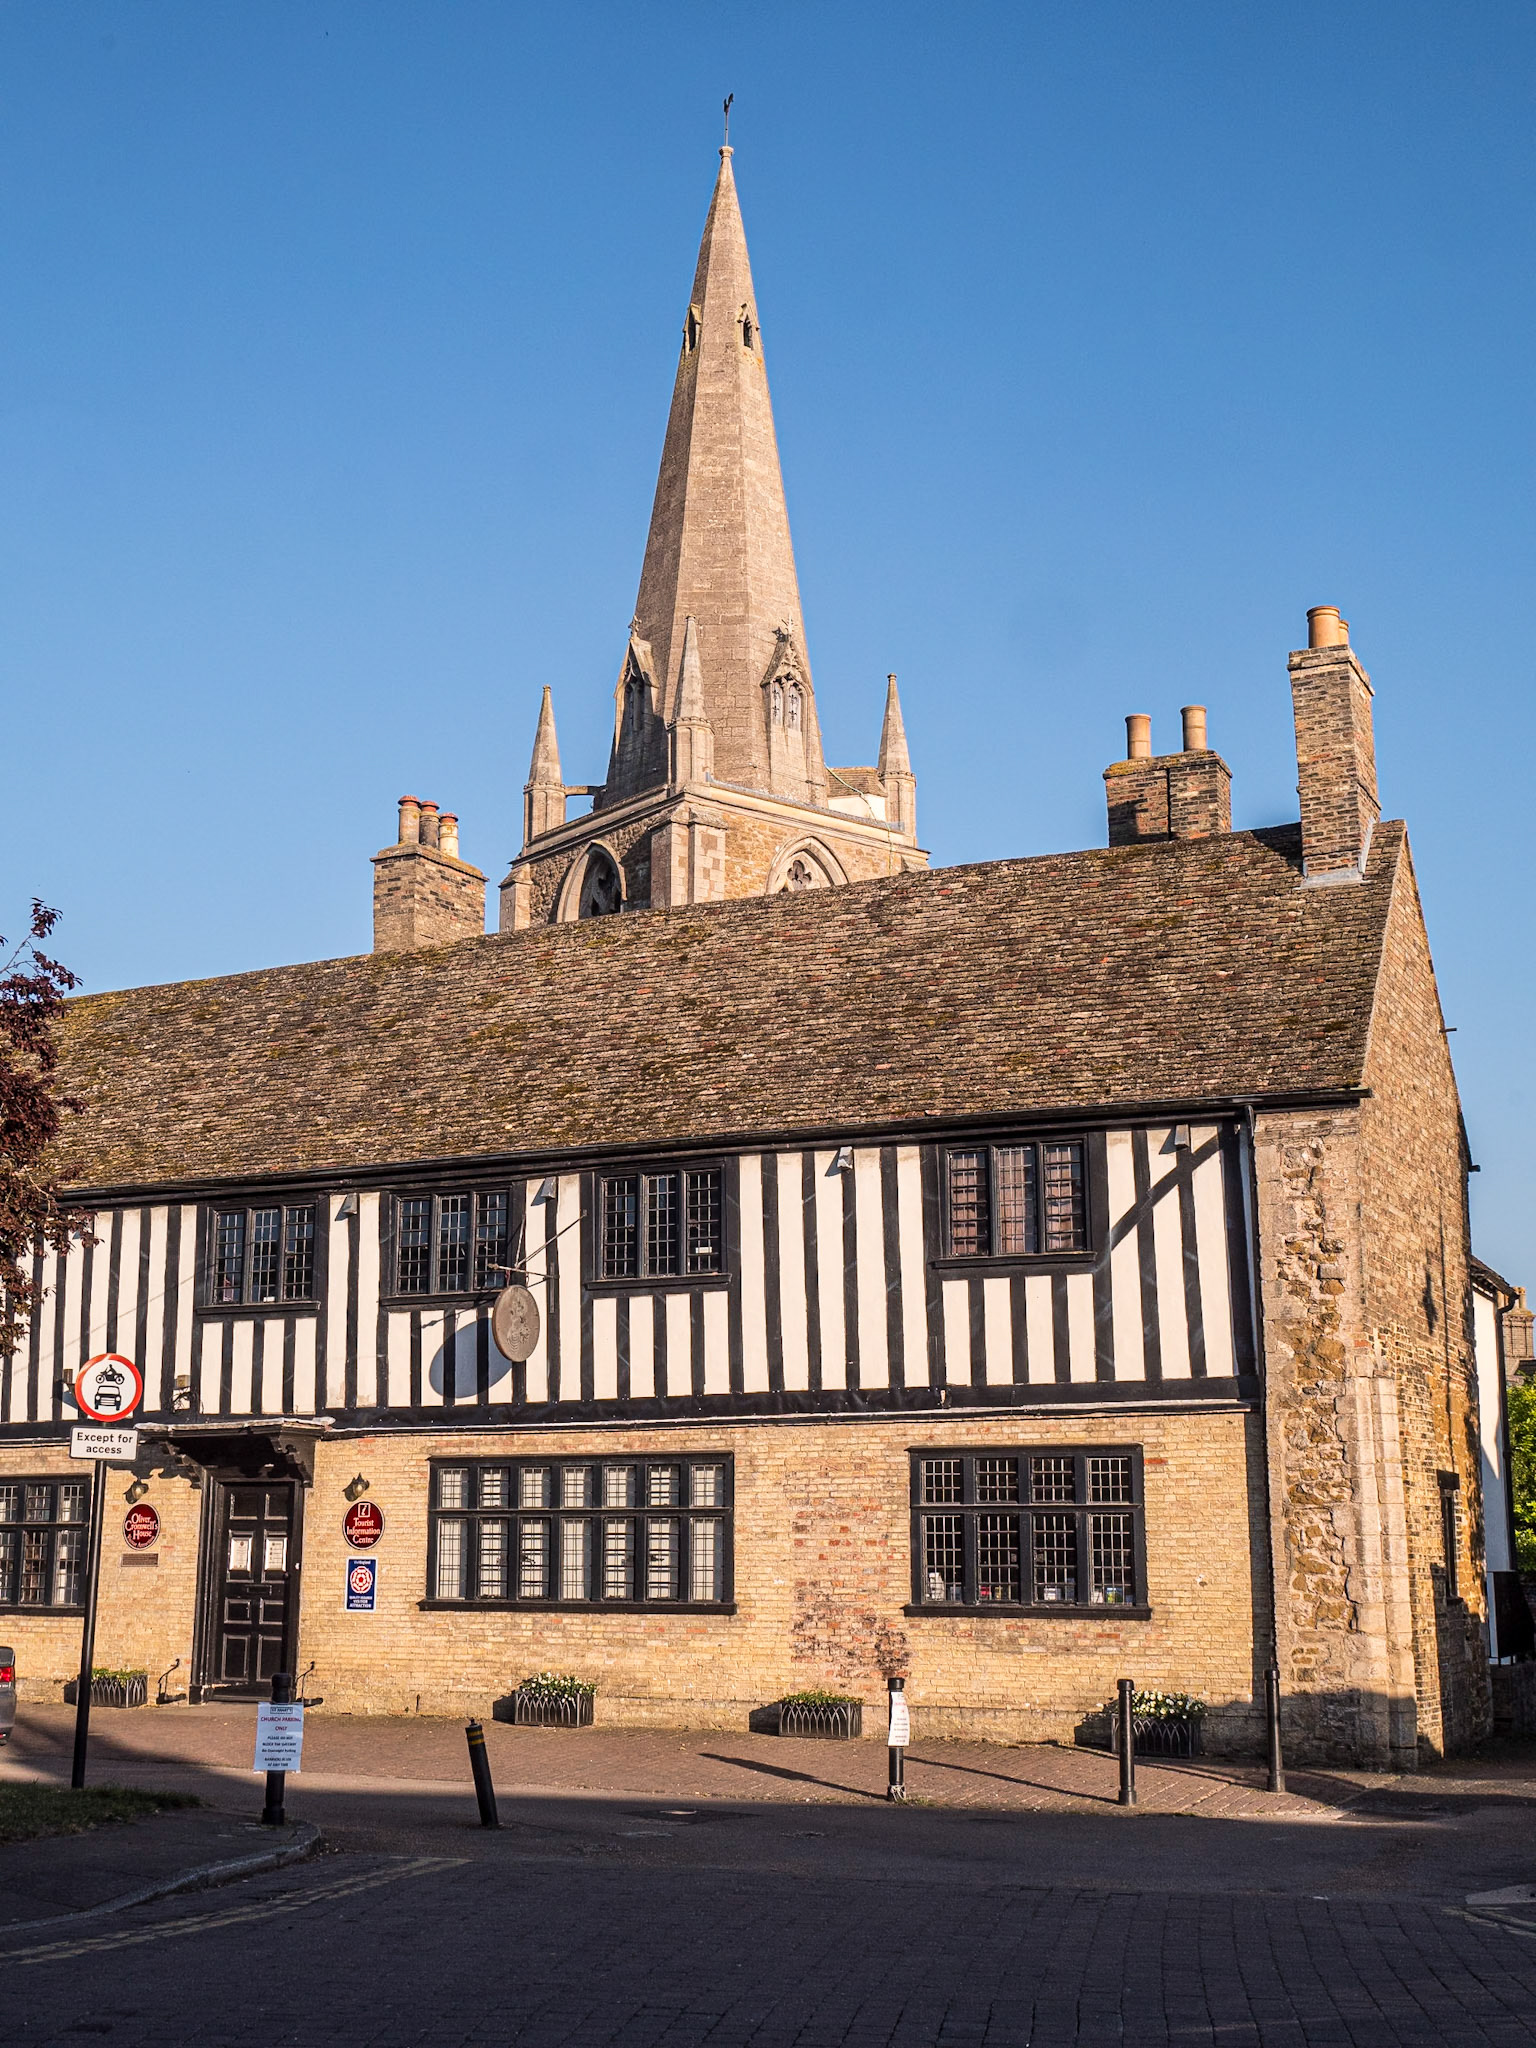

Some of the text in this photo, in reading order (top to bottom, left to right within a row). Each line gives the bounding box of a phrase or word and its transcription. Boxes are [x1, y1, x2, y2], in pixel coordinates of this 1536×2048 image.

[77, 1432, 133, 1443] Except for
[86, 1446, 122, 1454] access
[131, 1513, 151, 1524] Oliver
[353, 1517, 374, 1527] Tourist
[125, 1520, 159, 1531] Cromwell's
[346, 1526, 380, 1535] Information
[132, 1530, 152, 1540] House
[352, 1535, 374, 1544] Centre
